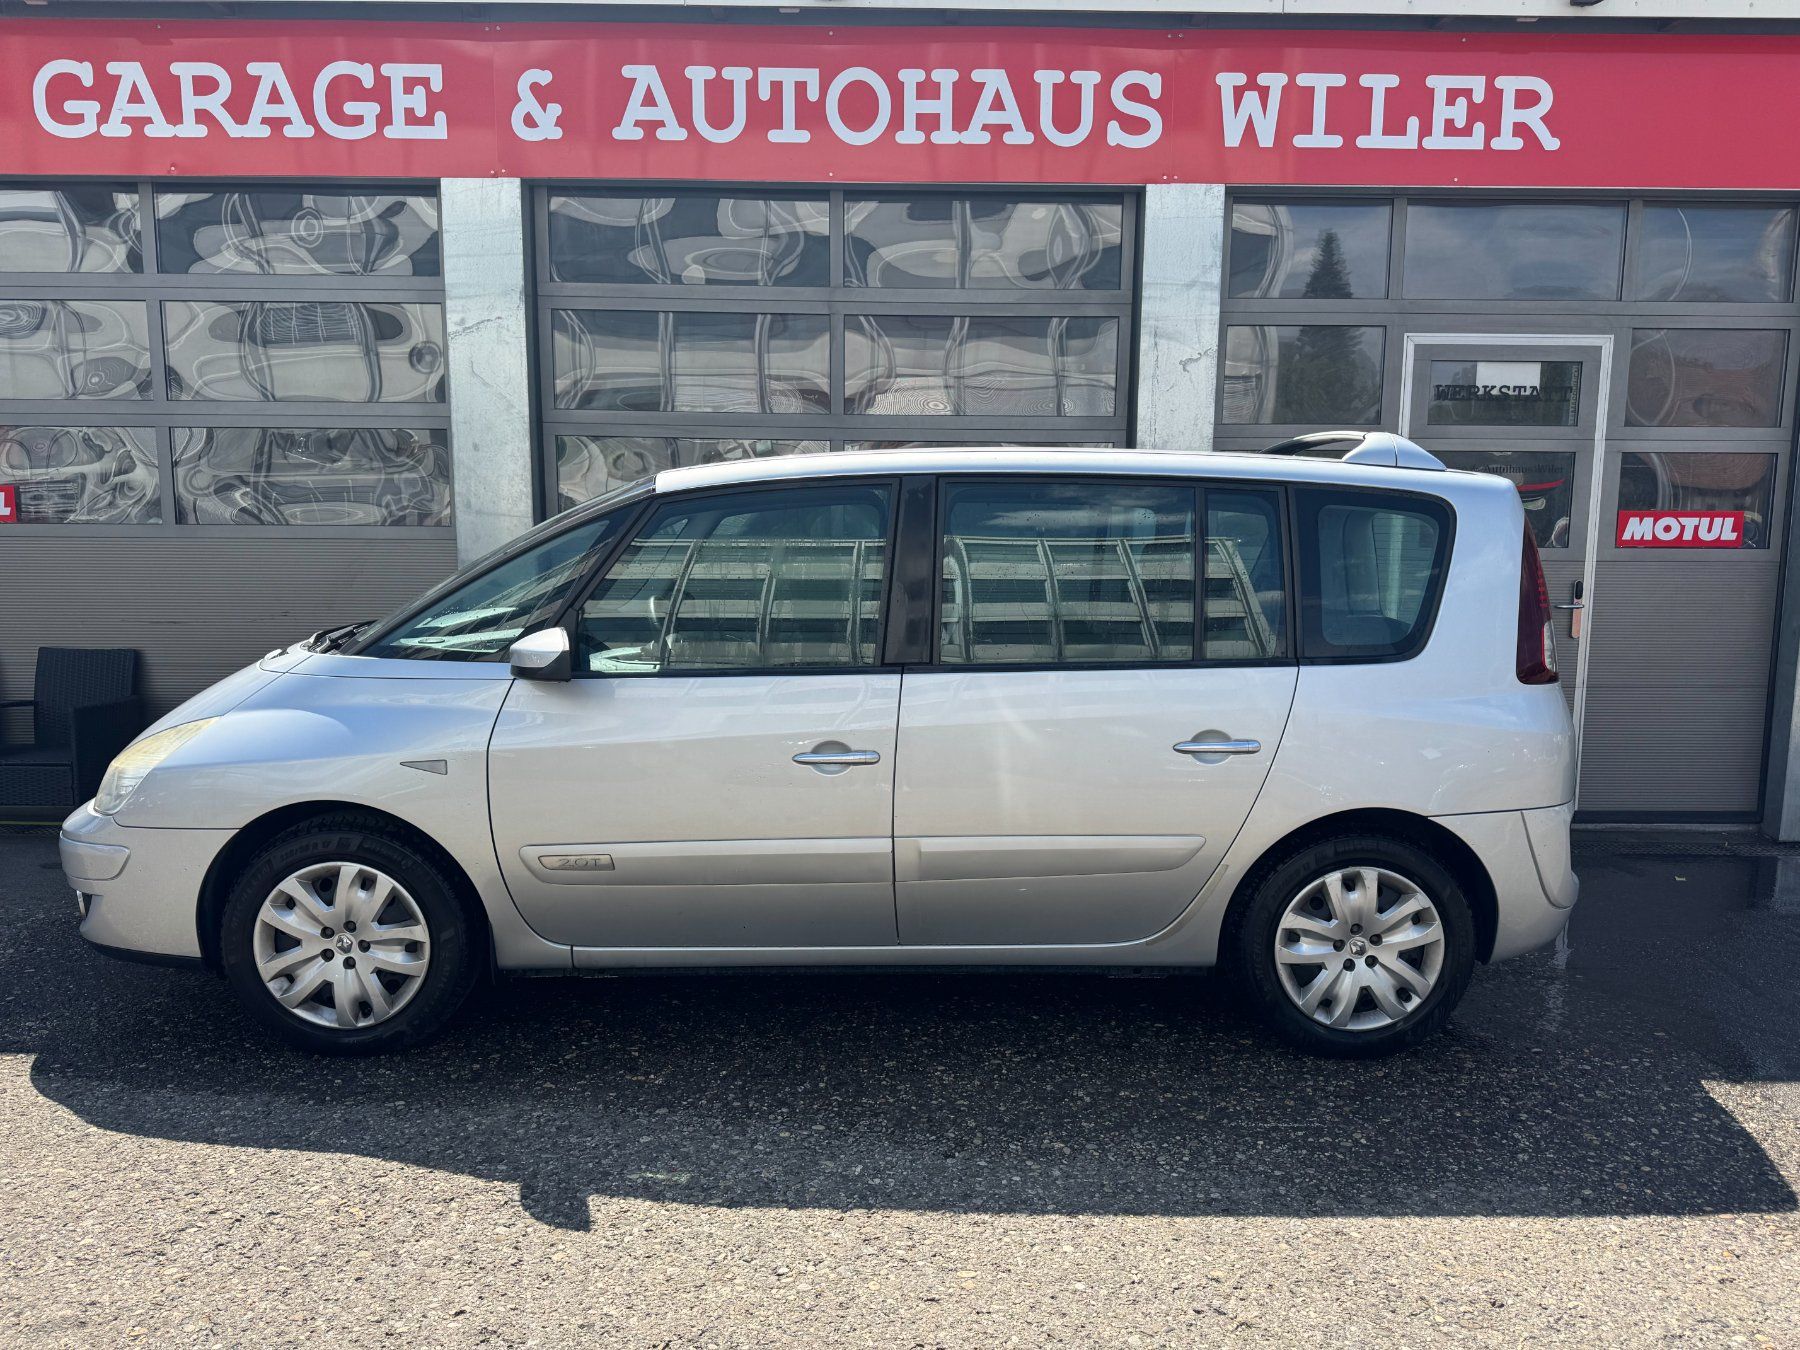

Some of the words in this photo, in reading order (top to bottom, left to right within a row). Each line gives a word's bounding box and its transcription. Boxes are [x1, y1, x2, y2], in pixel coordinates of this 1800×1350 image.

[33, 59, 447, 139] GARAGE
[511, 69, 563, 141] &
[612, 65, 1162, 148] AUTOHAUS
[1216, 73, 1560, 150] WILER
[1434, 384, 1572, 401] WERKSTATT
[1622, 517, 1737, 540] MOTUL
